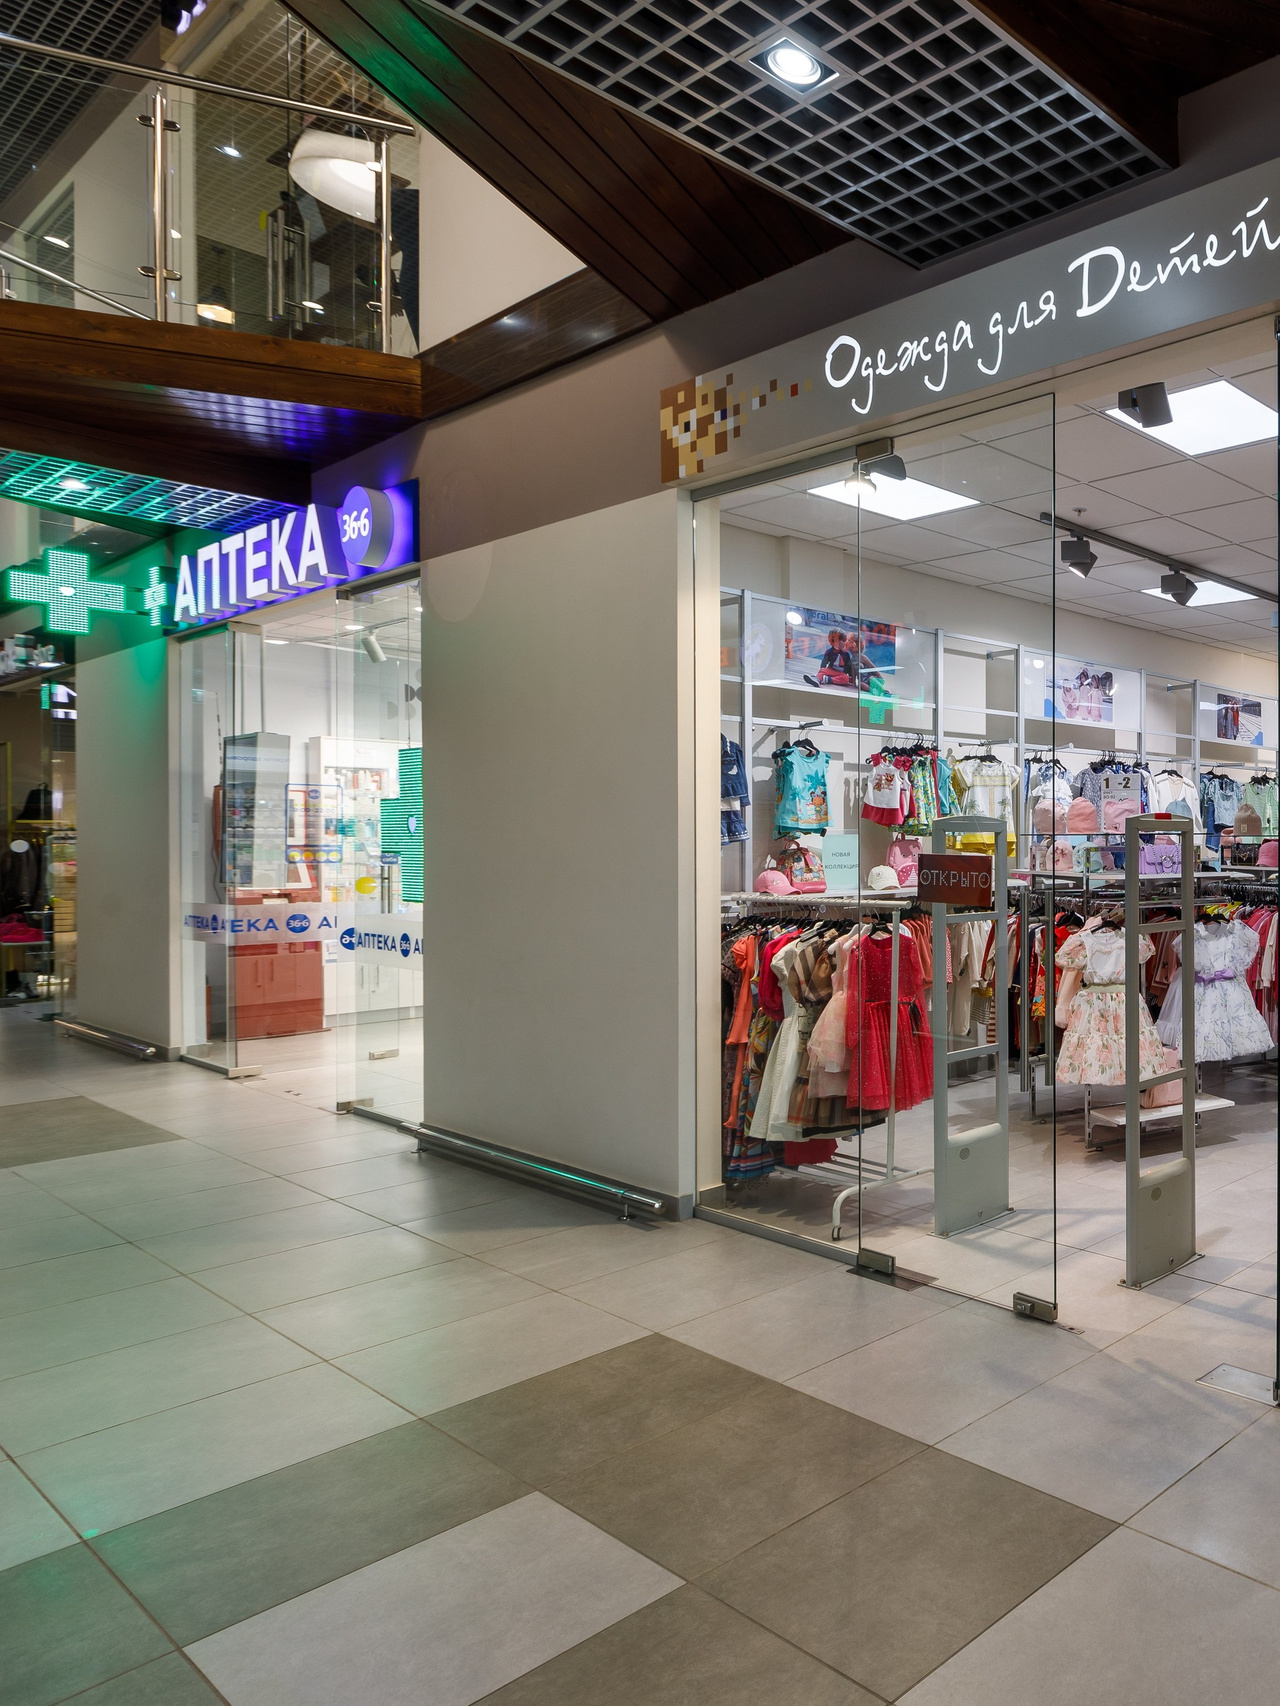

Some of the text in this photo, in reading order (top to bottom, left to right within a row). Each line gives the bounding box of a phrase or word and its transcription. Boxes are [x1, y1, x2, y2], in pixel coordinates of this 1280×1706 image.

[825, 320, 973, 414] Одежда
[978, 290, 1056, 375] для
[174, 503, 327, 622] АПТЕКА
[919, 869, 991, 889] ОТКРЫТО
[356, 932, 398, 952] АПТЕКА
